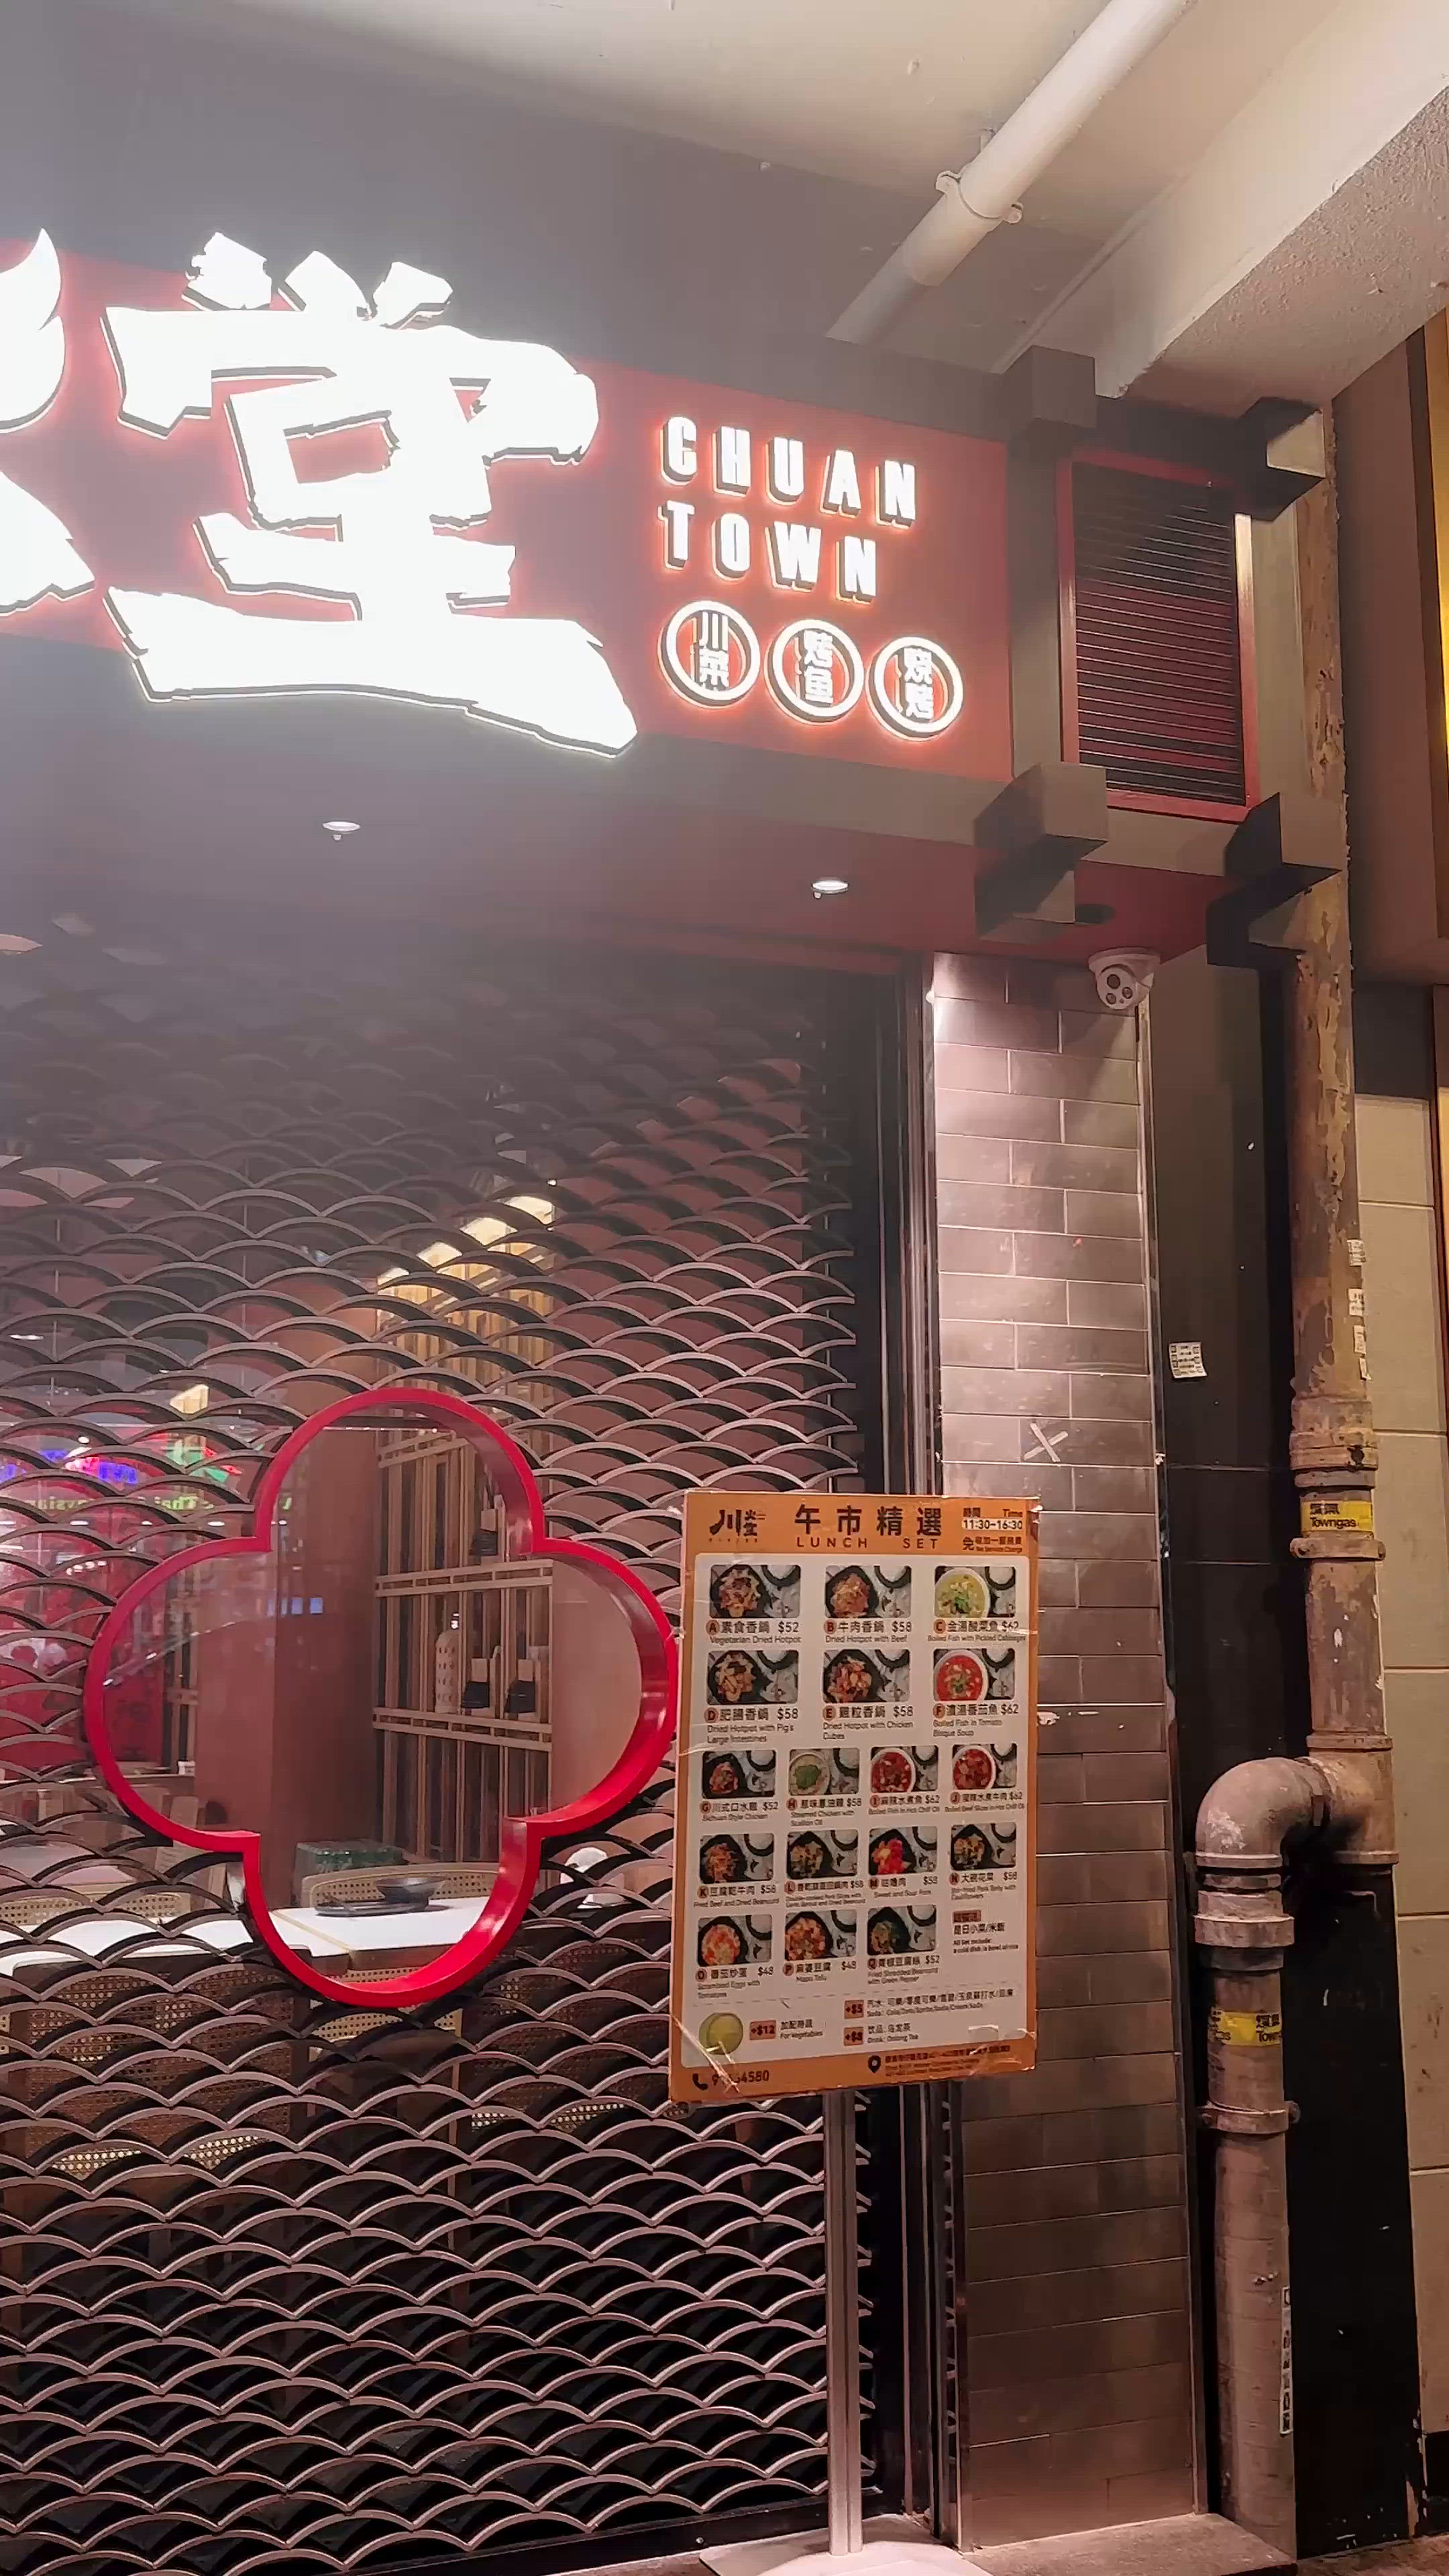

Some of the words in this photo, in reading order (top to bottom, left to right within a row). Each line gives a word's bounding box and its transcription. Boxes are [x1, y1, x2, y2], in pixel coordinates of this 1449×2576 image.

[660, 415, 916, 528] CHUAN
[659, 500, 877, 603] TOWN
[794, 1504, 941, 1537] 午市精選
[963, 1519, 1023, 1530] 11:30-16:30
[1309, 1517, 1356, 1529] Towngas
[796, 1536, 868, 1549] LUNCH
[902, 1538, 938, 1549] SET
[777, 1621, 799, 1633] $52
[777, 1708, 798, 1720] $58
[893, 1706, 913, 1717] $58
[1001, 1704, 1019, 1715] $62
